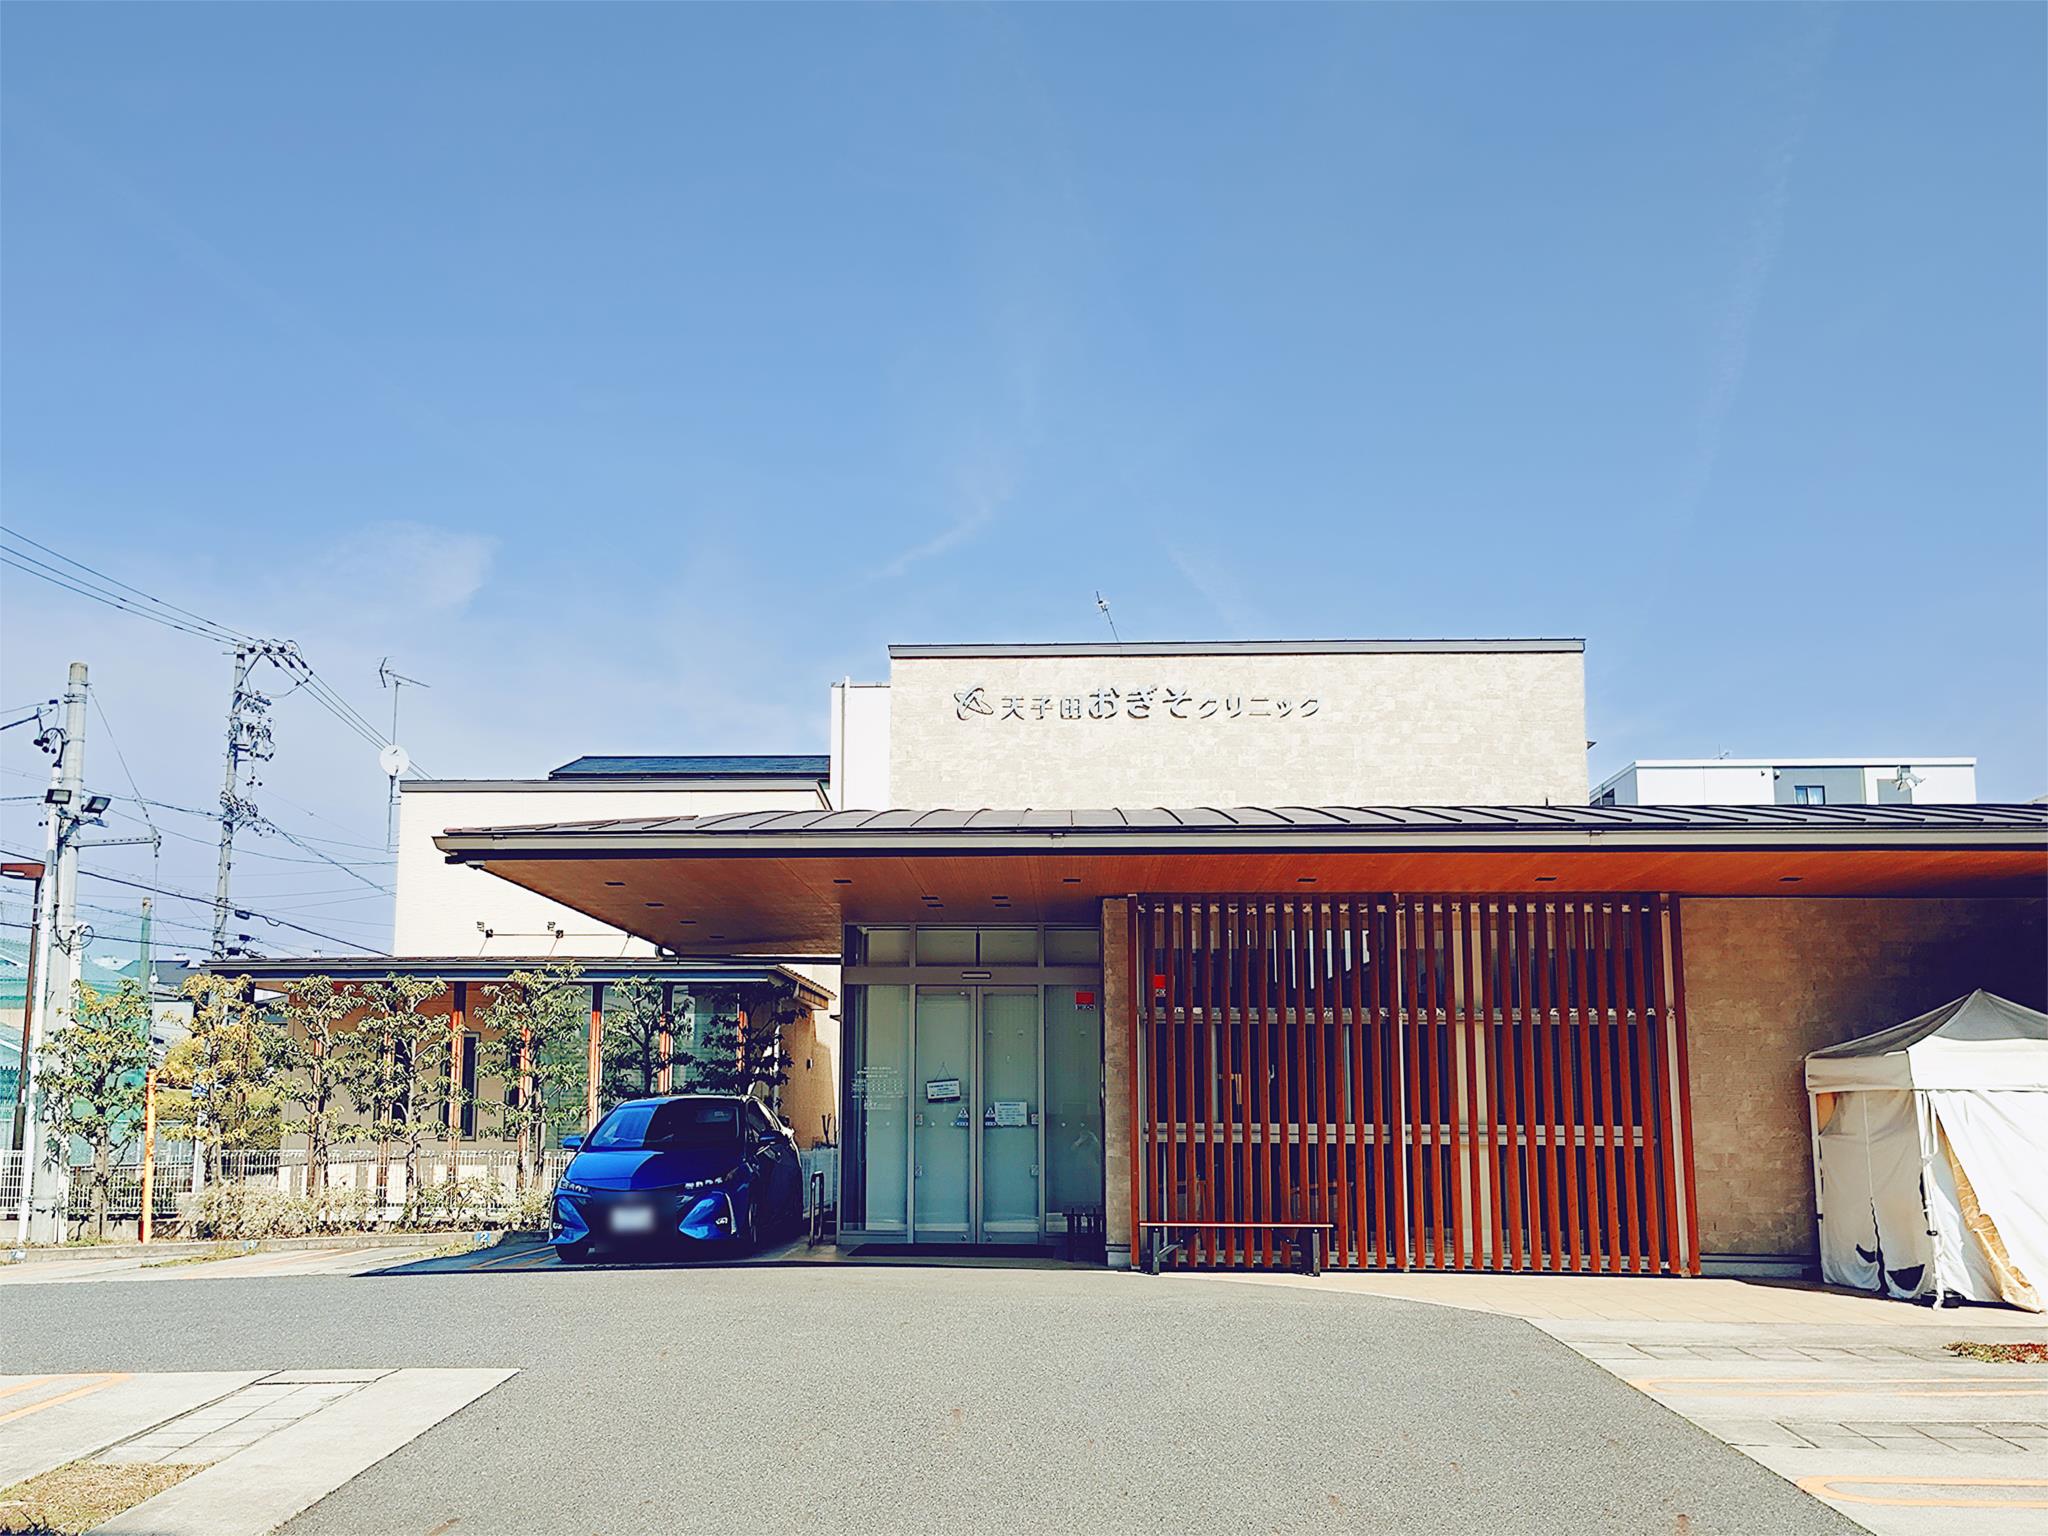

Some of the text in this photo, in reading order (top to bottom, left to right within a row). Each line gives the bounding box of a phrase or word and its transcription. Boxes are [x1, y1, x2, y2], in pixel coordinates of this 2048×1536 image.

[1000, 687, 1321, 720] 天子田おぎそクリニック
